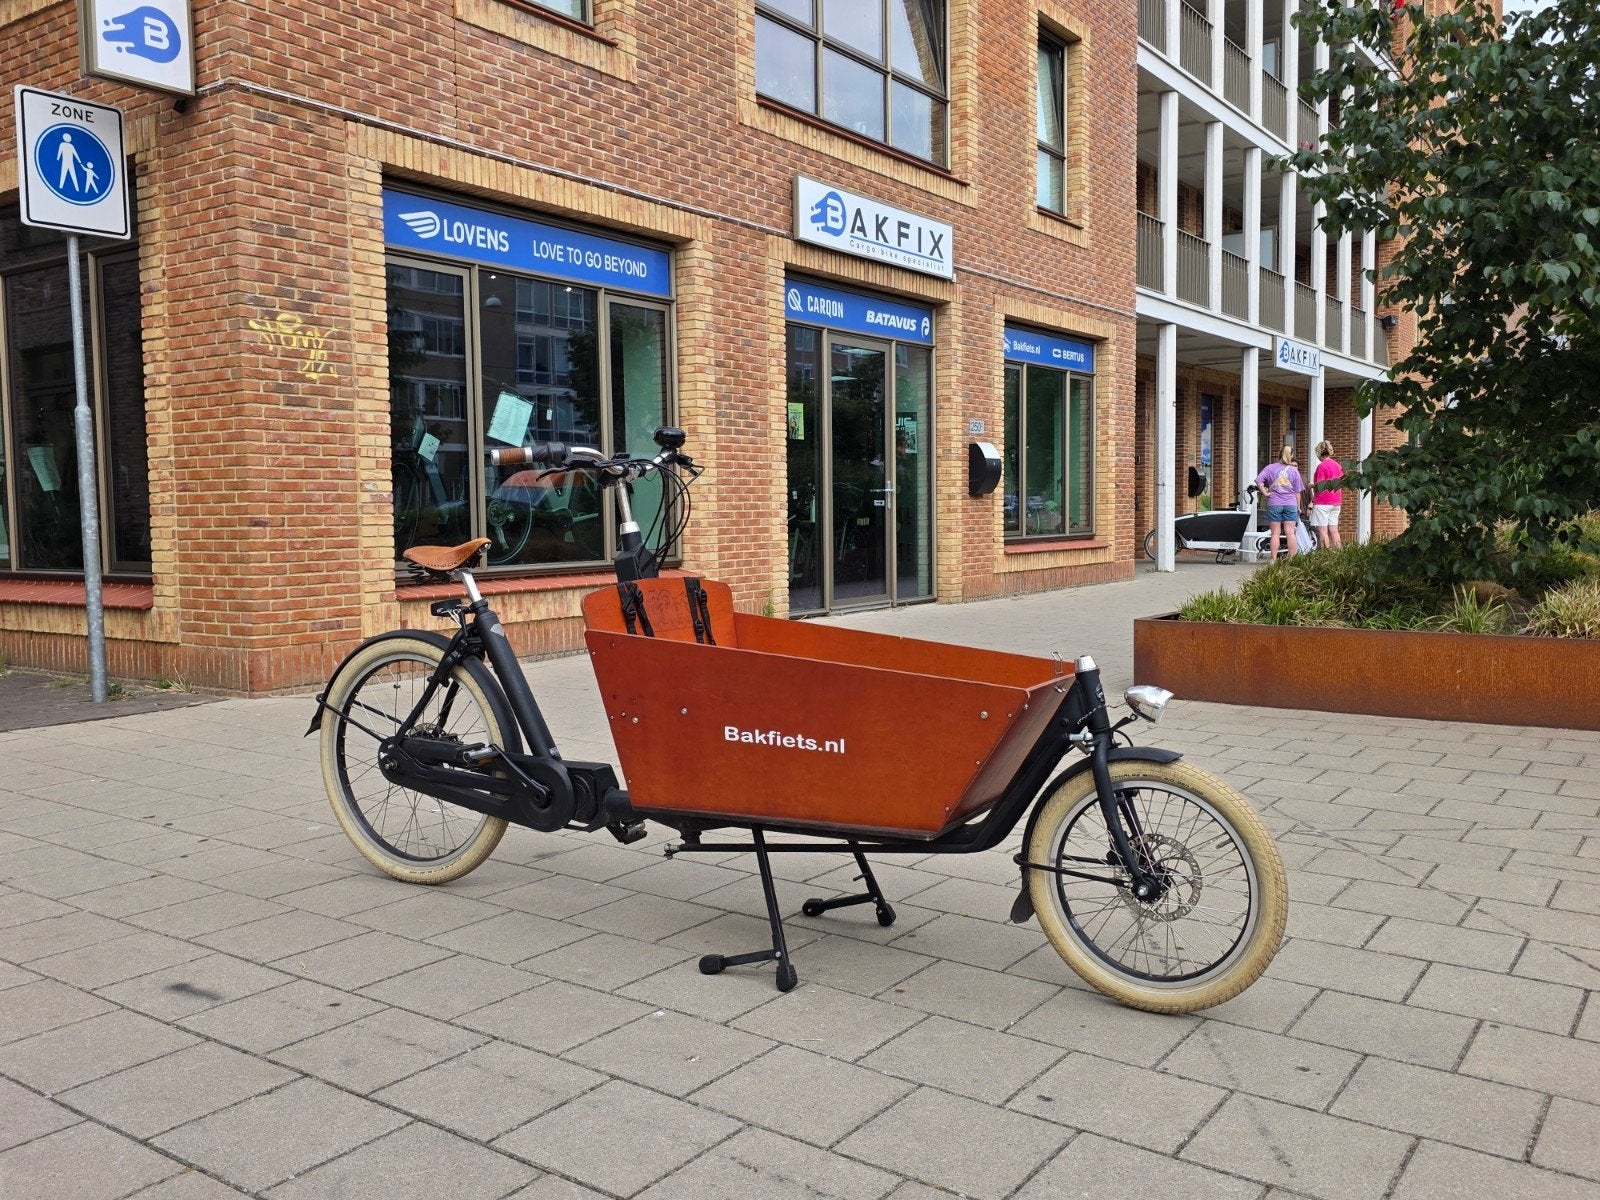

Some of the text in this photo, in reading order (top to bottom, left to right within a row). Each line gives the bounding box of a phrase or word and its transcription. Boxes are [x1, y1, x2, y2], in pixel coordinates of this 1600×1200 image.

[143, 16, 170, 50] B
[51, 103, 95, 123] ZONE
[443, 219, 509, 252] LOVENS
[825, 196, 944, 259] BAKFIX
[533, 240, 647, 278] LOVE TO GO BEYOND
[850, 240, 944, 271] Cargo bike specialist
[807, 295, 844, 318] CARQON
[866, 310, 917, 331] BATAVUS
[1013, 341, 1040, 354] Bakfiets.nl
[1063, 349, 1085, 362] BERTUS
[724, 725, 846, 754] Bakfiets.nl
